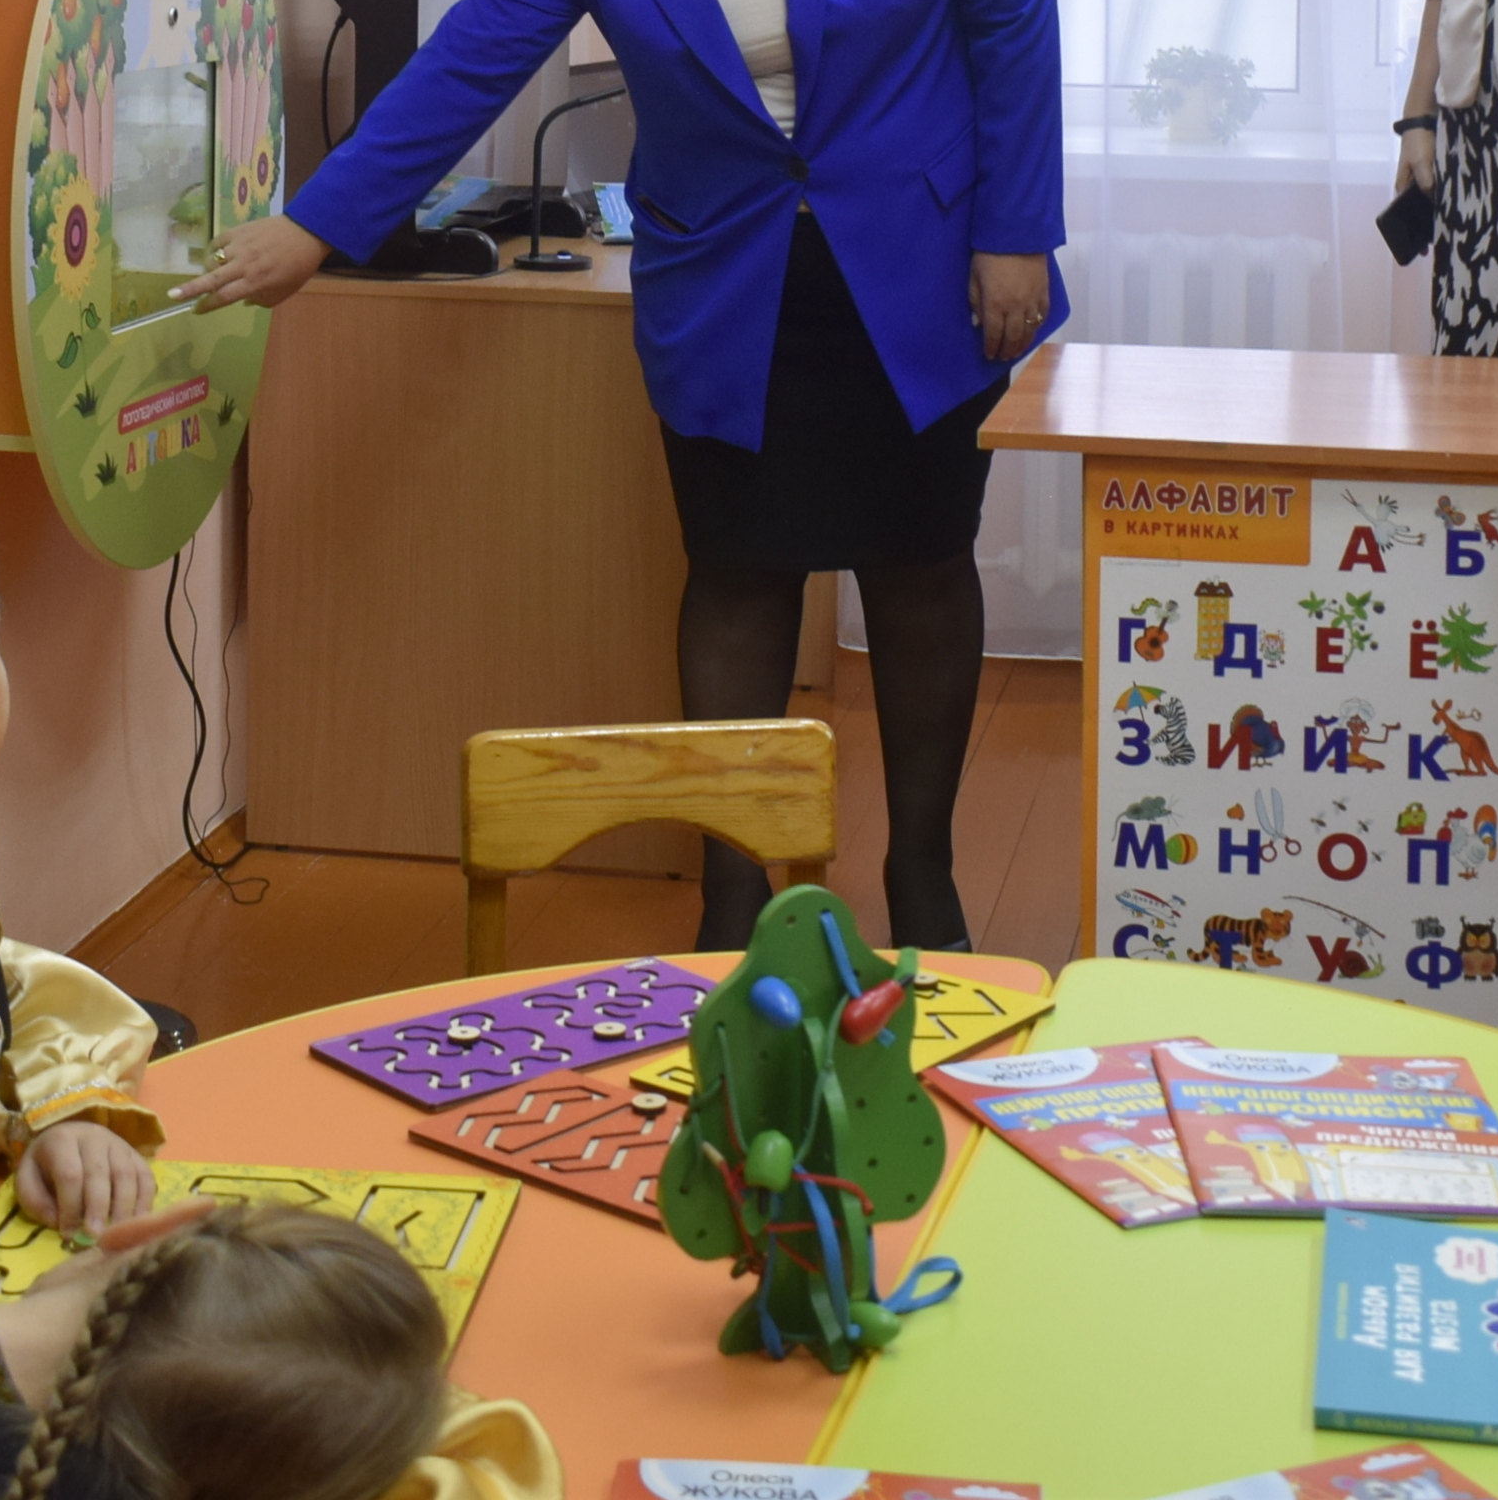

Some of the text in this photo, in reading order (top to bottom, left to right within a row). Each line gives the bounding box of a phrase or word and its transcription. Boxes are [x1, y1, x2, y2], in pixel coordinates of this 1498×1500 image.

[125, 413, 201, 475] АНТОШКА
[1103, 478, 1295, 517] АЛФАВИТ
[1104, 519, 1239, 540] В КАРТИНКАХ
[1339, 526, 1386, 573] А
[1444, 529, 1485, 576] Б
[1118, 617, 1146, 663] Г
[1213, 622, 1263, 678] Д
[1315, 627, 1345, 673] Е
[1409, 619, 1439, 679] Ё
[1115, 718, 1150, 766] З
[1207, 723, 1252, 770] И
[1303, 714, 1348, 773] Й
[1408, 734, 1450, 781] К
[1114, 822, 1168, 869] М
[1218, 828, 1261, 874] Н
[1318, 833, 1367, 881] О
[1407, 838, 1449, 885] П
[1210, 930, 1241, 969] Т
[1307, 935, 1351, 982] У
[1406, 941, 1462, 988] Ф
[987, 1063, 1084, 1082] ЖУКОВА
[1208, 1060, 1312, 1075] ЖУКОВА
[1182, 1083, 1477, 1109] НЕЙРОЛОГОПЕДИЧЕСКИЕ
[1358, 1124, 1457, 1142] ЧИТАЕМ
[680, 1483, 819, 1500] ЖУКОВА
[710, 1469, 794, 1486] Олеся
